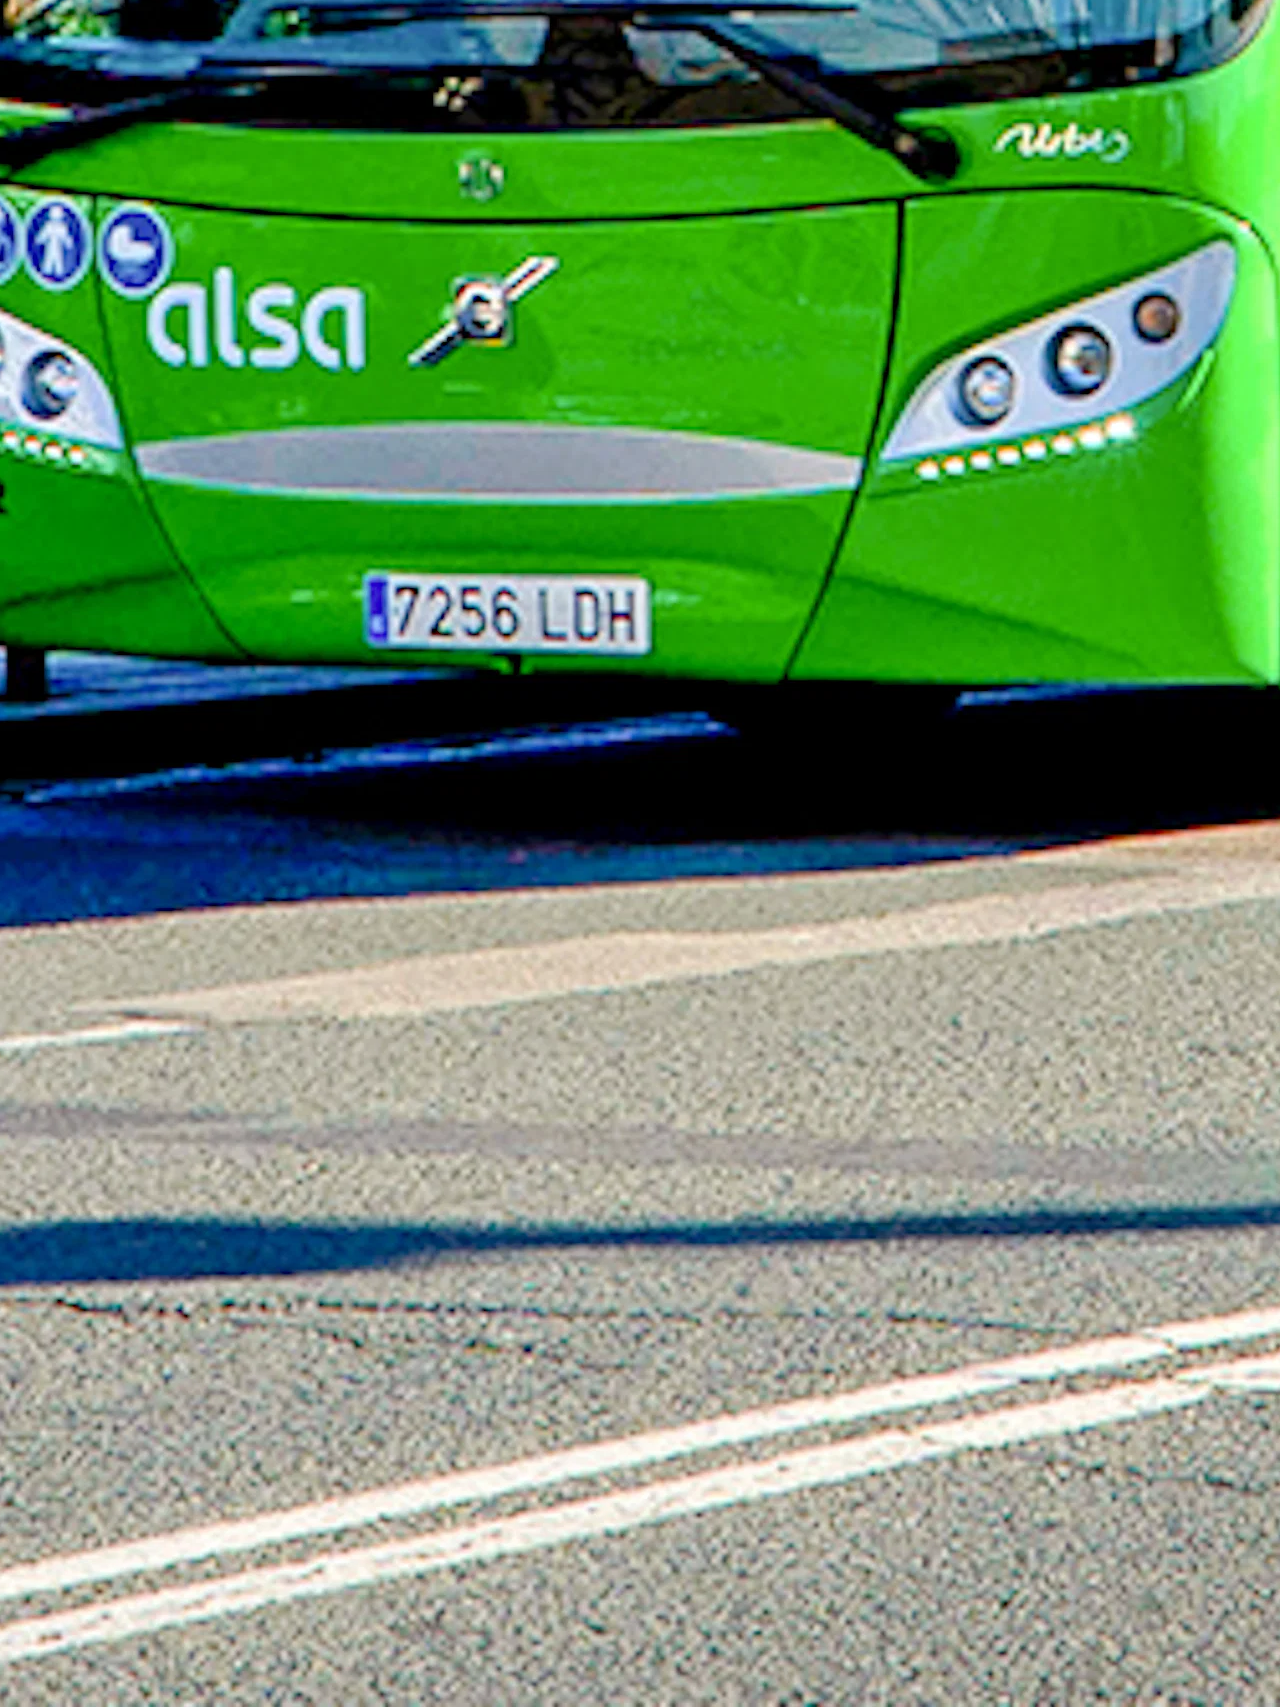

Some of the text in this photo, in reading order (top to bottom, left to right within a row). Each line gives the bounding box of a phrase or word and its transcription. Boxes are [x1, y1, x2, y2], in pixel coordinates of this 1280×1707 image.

[147, 266, 369, 372] alsa
[395, 584, 637, 643] 7256 LDH
